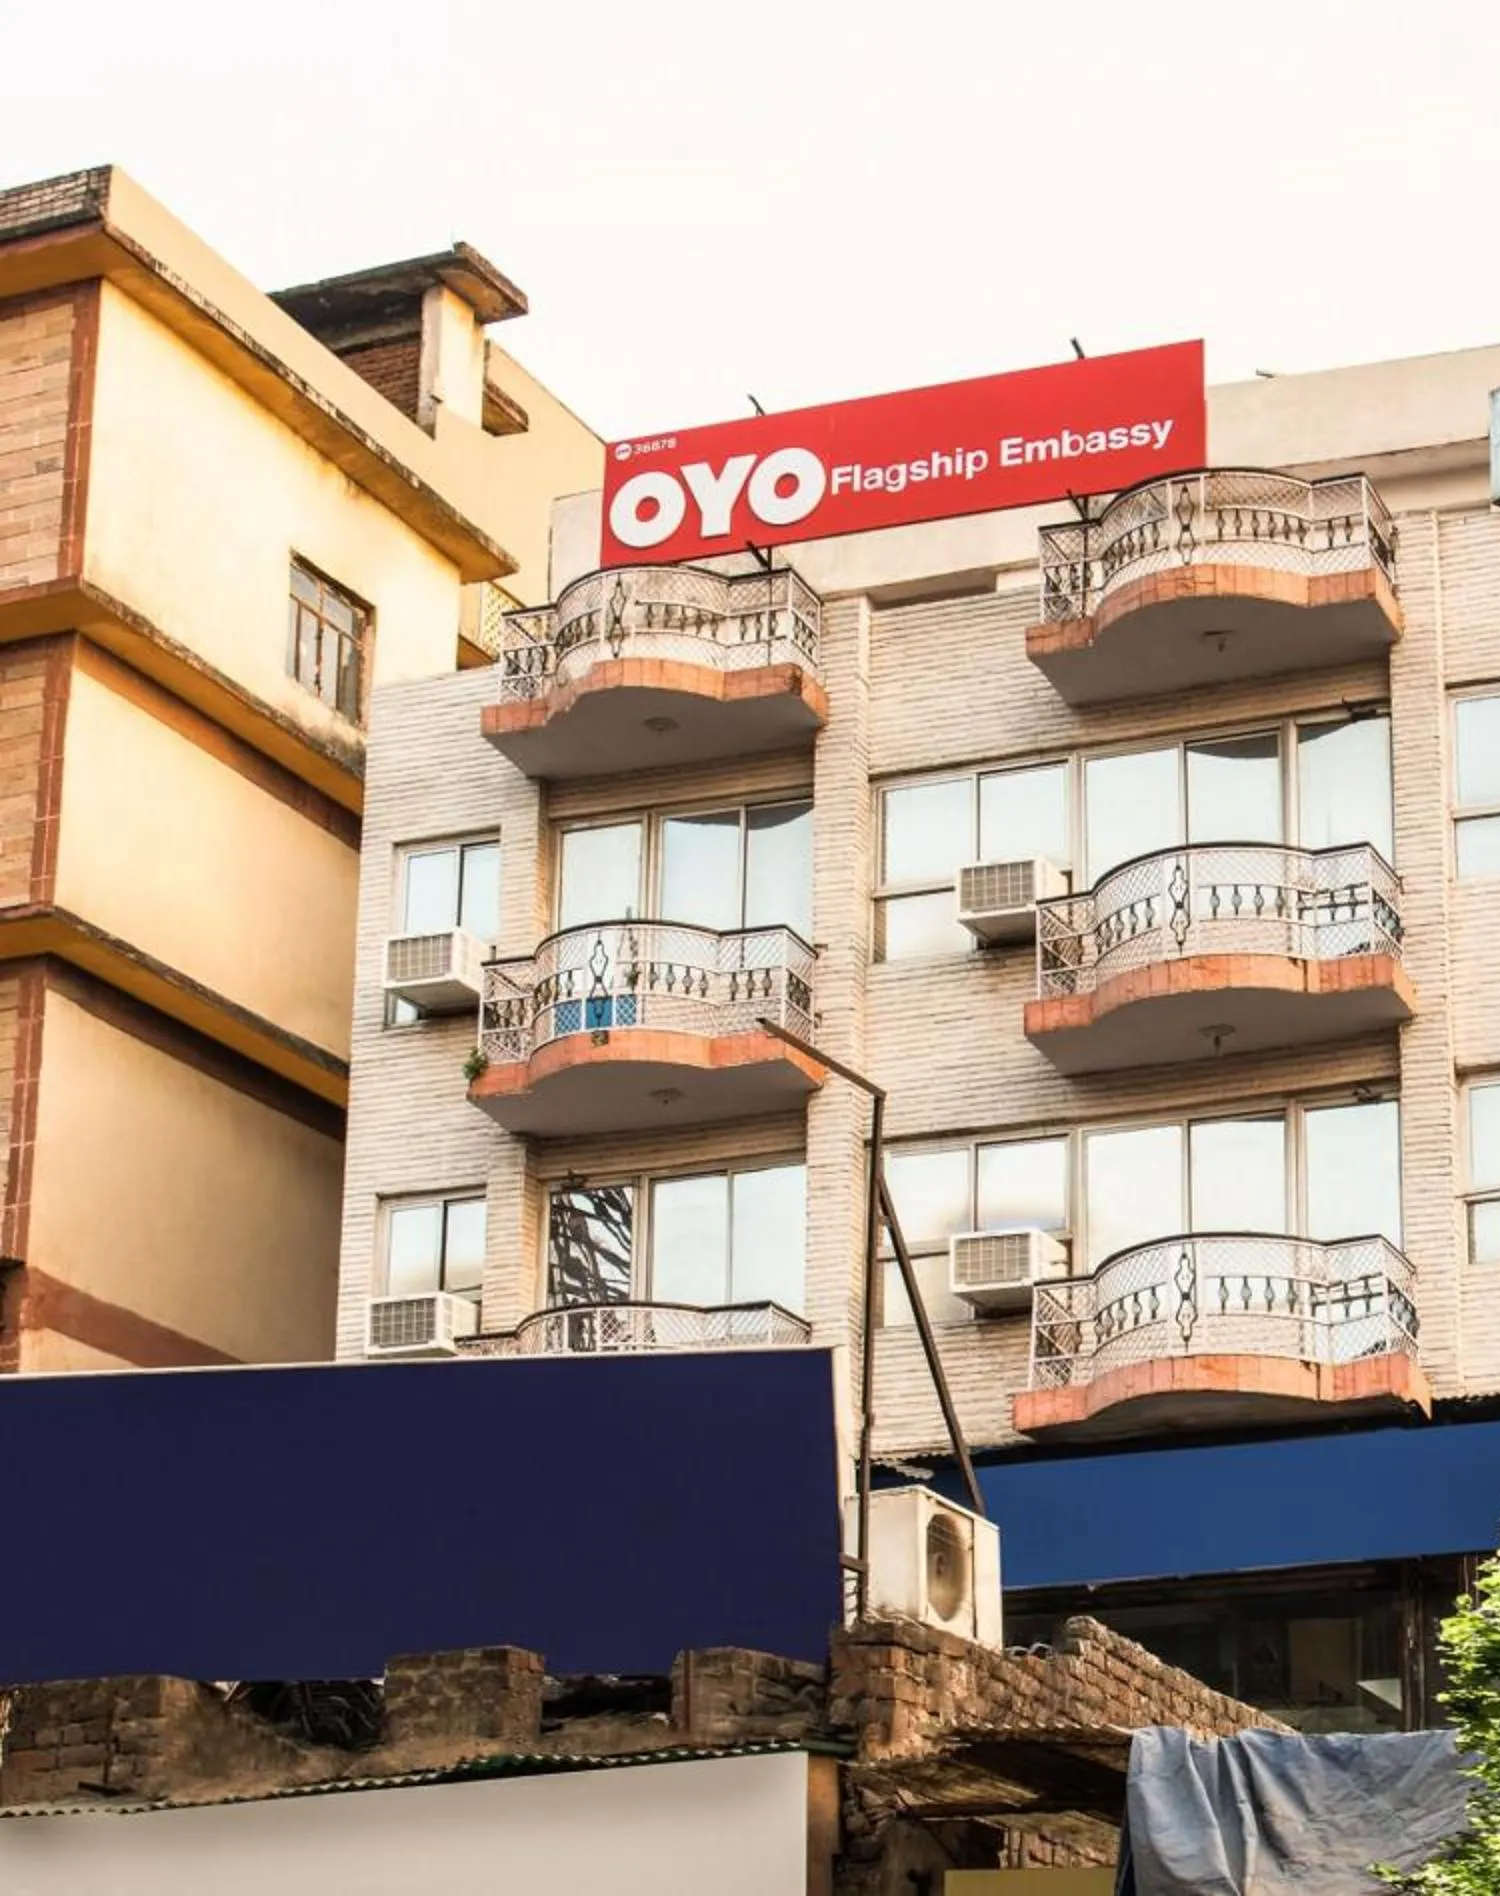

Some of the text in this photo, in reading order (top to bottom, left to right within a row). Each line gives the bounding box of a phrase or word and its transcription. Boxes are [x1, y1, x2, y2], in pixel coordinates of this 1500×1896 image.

[609, 419, 1173, 548] OYO Flagship Embassy
